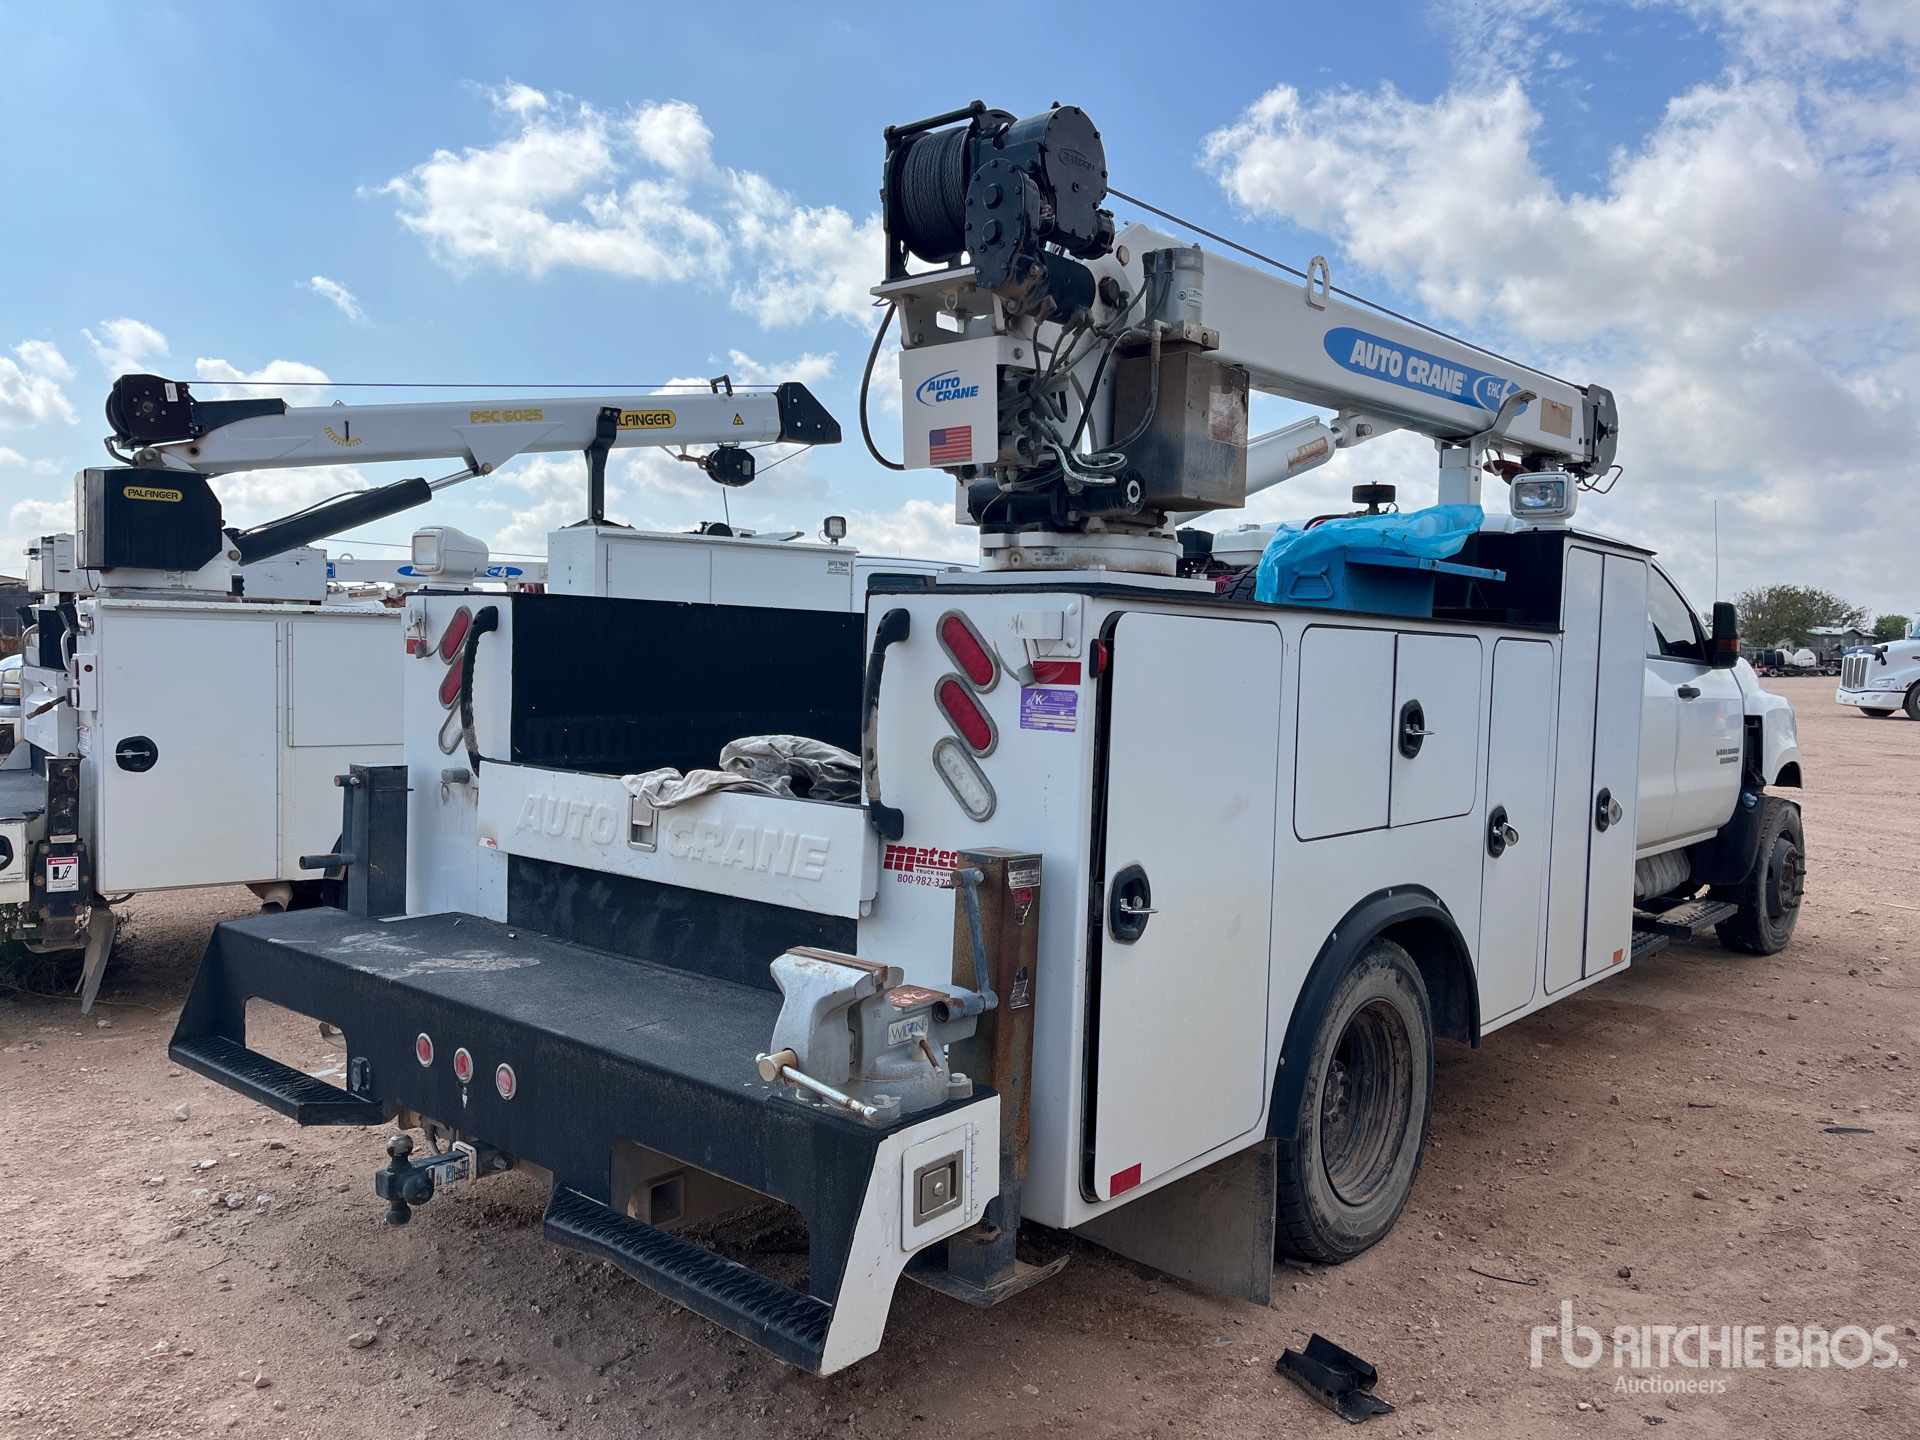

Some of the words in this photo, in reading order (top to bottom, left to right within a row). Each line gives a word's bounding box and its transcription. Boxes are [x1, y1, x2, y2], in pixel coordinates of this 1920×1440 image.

[1349, 338, 1404, 378] AUTO
[1405, 356, 1464, 396] CRANE
[1486, 381, 1502, 399] EHC
[926, 376, 961, 393] AUTO
[935, 385, 979, 403] CRANE
[469, 410, 501, 424] PSC
[502, 408, 544, 423] 6025
[127, 488, 179, 500] PALFINGER
[516, 793, 620, 847] AUTO
[666, 815, 832, 882] CRANE
[916, 868, 935, 876] TRUCK
